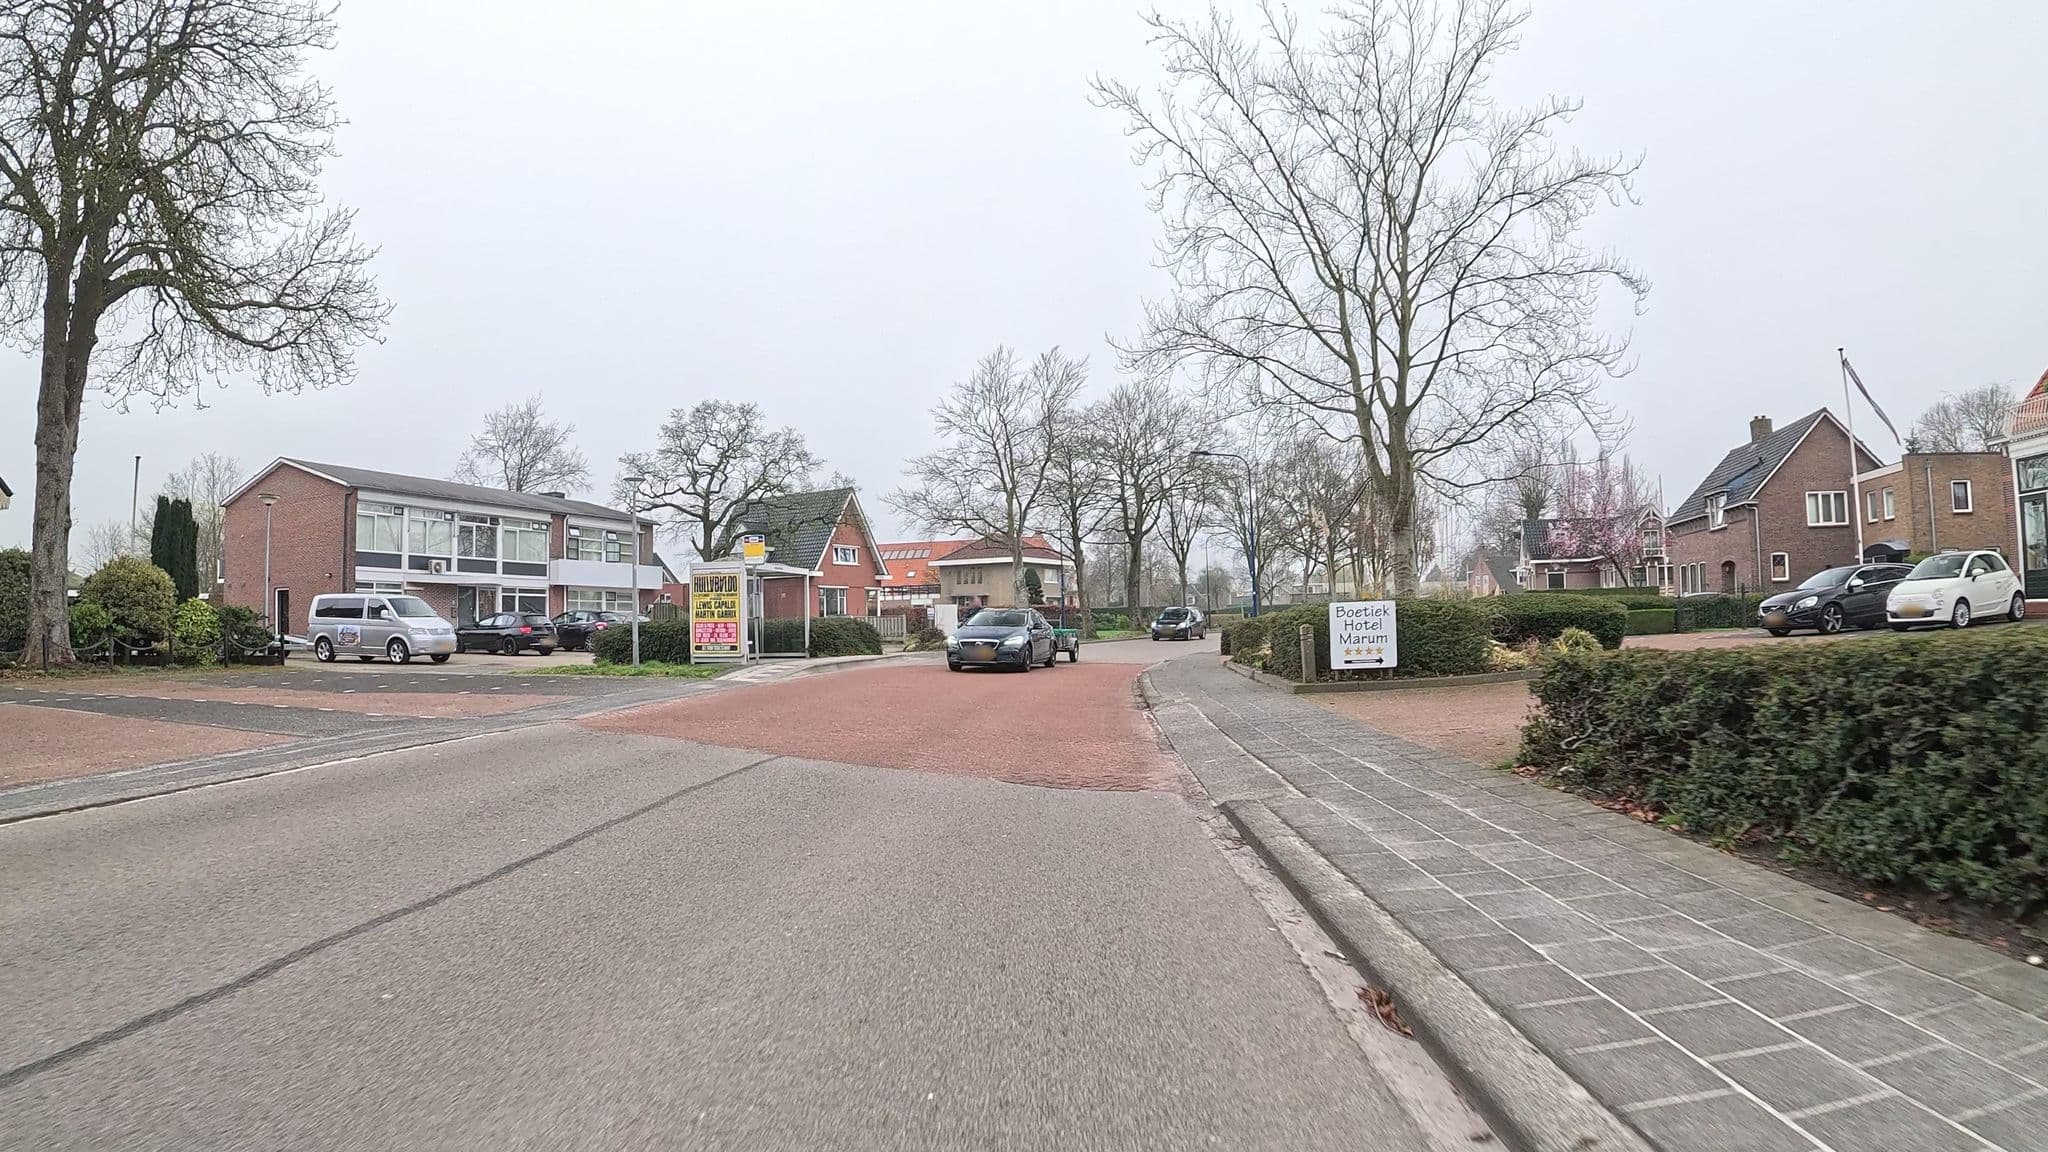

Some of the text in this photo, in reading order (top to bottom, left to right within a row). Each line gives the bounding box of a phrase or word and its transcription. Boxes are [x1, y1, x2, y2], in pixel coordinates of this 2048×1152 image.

[696, 600, 736, 609] LEWIS CAPALDI
[695, 610, 715, 618] MARTIN
[1336, 605, 1390, 618] Boetiek
[1344, 618, 1383, 631] Hotel
[1339, 633, 1388, 645] Marum
